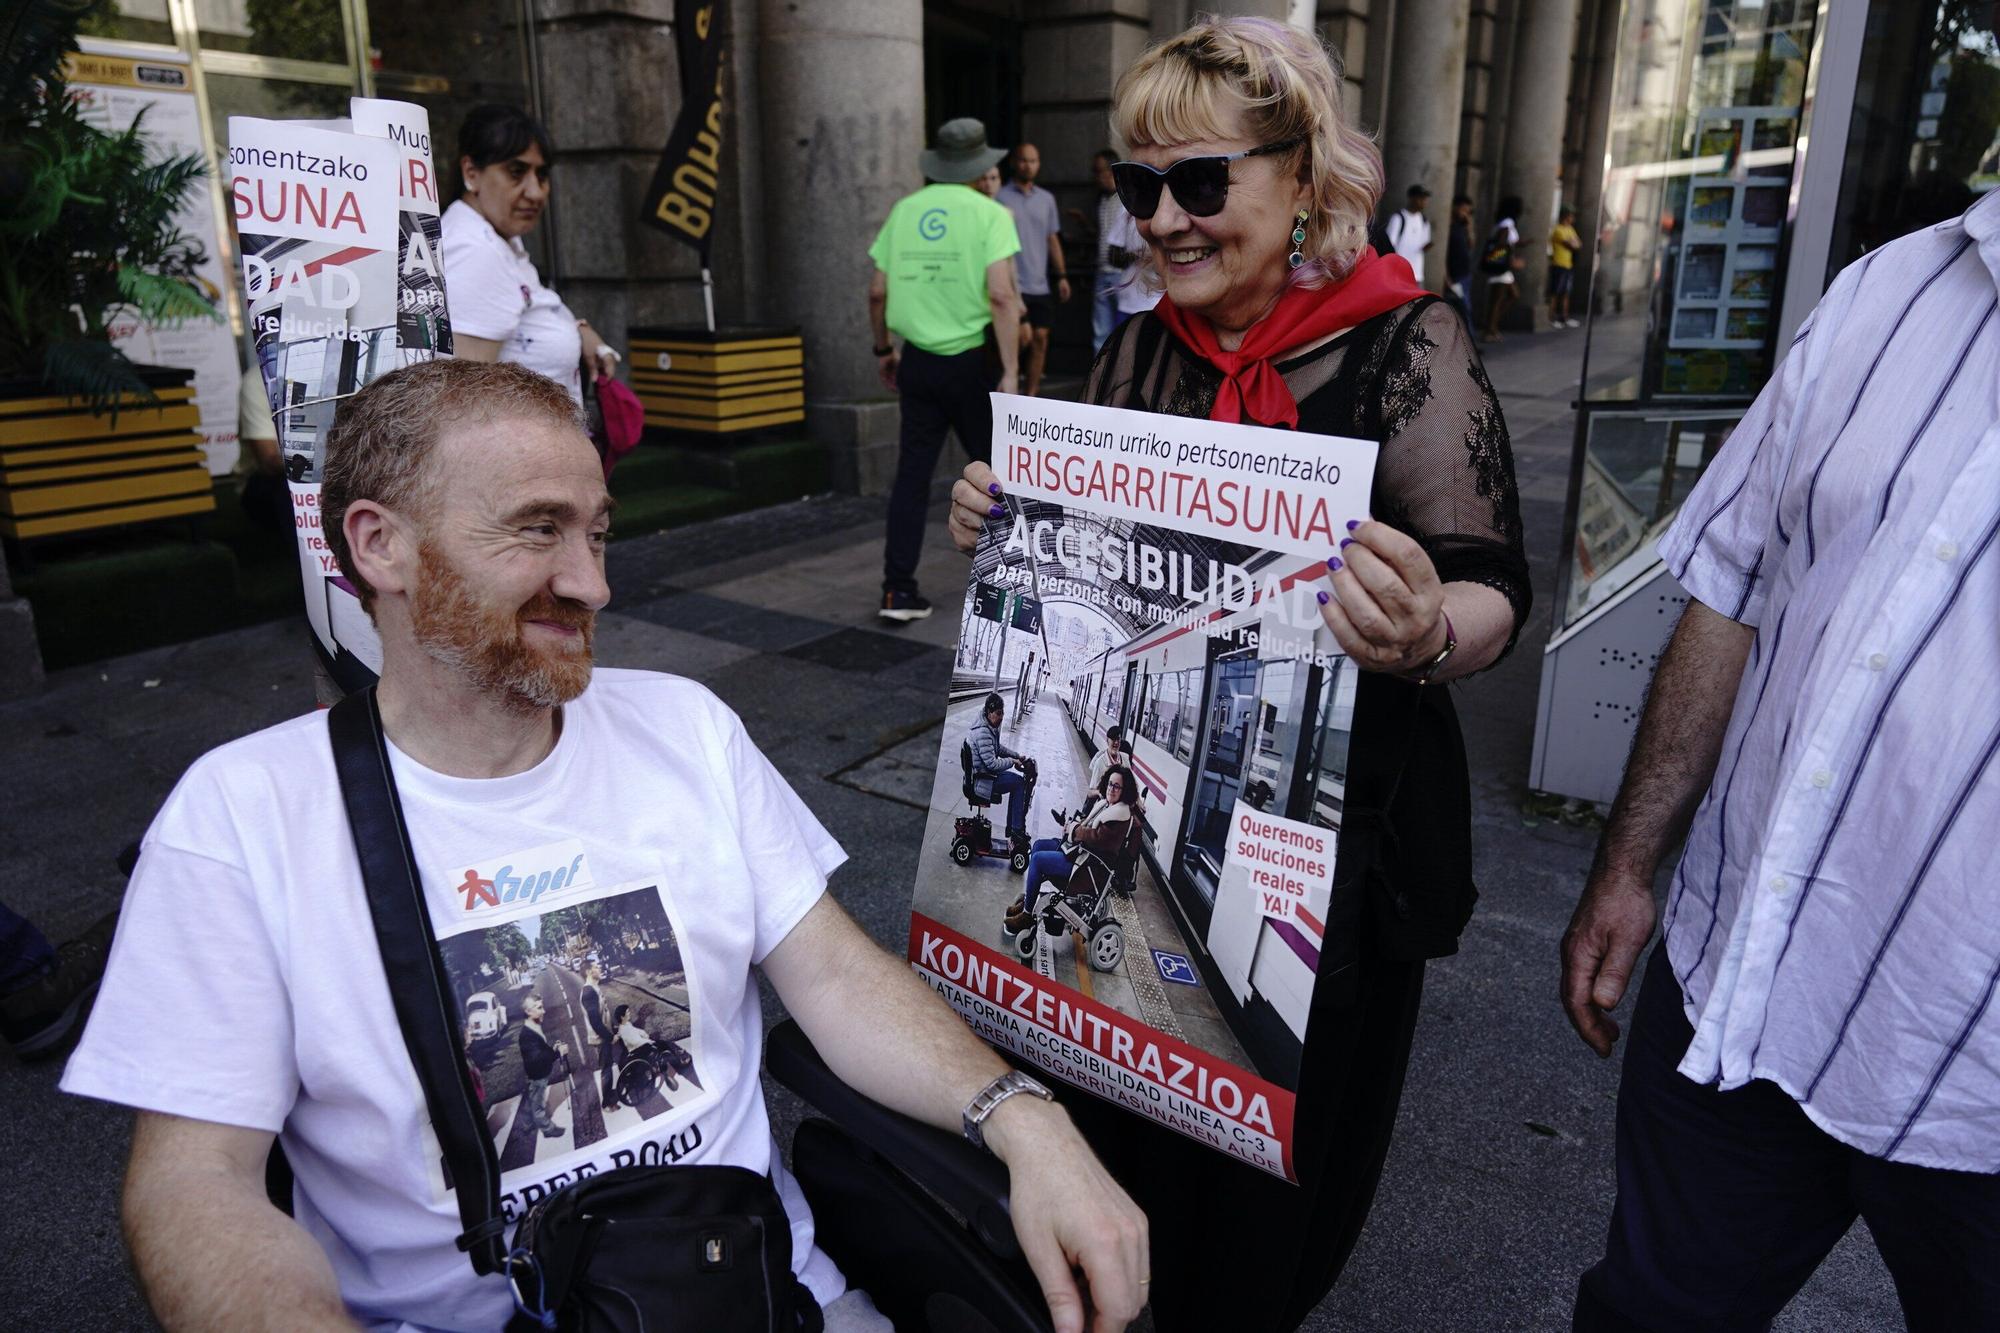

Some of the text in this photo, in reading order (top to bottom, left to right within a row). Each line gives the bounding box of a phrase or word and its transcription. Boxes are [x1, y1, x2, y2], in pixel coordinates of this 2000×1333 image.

[233, 176, 367, 234] SUNA
[1008, 414, 1341, 485] Mugikortasun urriko pertsonentzako
[1008, 445, 1335, 546] IRISGARRITASUNA
[994, 564, 1329, 667] para personas con movilidad reducida
[1003, 514, 1325, 631] ACCESIBILIDAD
[1238, 841, 1326, 878] soluciones
[1240, 815, 1324, 854] Queremos
[1253, 869, 1304, 896] reales
[1263, 893, 1290, 916] YA!
[920, 931, 1276, 1137] KONTZENTRAZIOA
[1021, 1042, 1220, 1146] IRISGARRITASUNAREN
[1228, 1142, 1281, 1173] ALDE
[1026, 1027, 1160, 1102] ACCESIBILIDAD
[1168, 1095, 1227, 1135] LINEA
[1232, 1127, 1266, 1152] C-3
